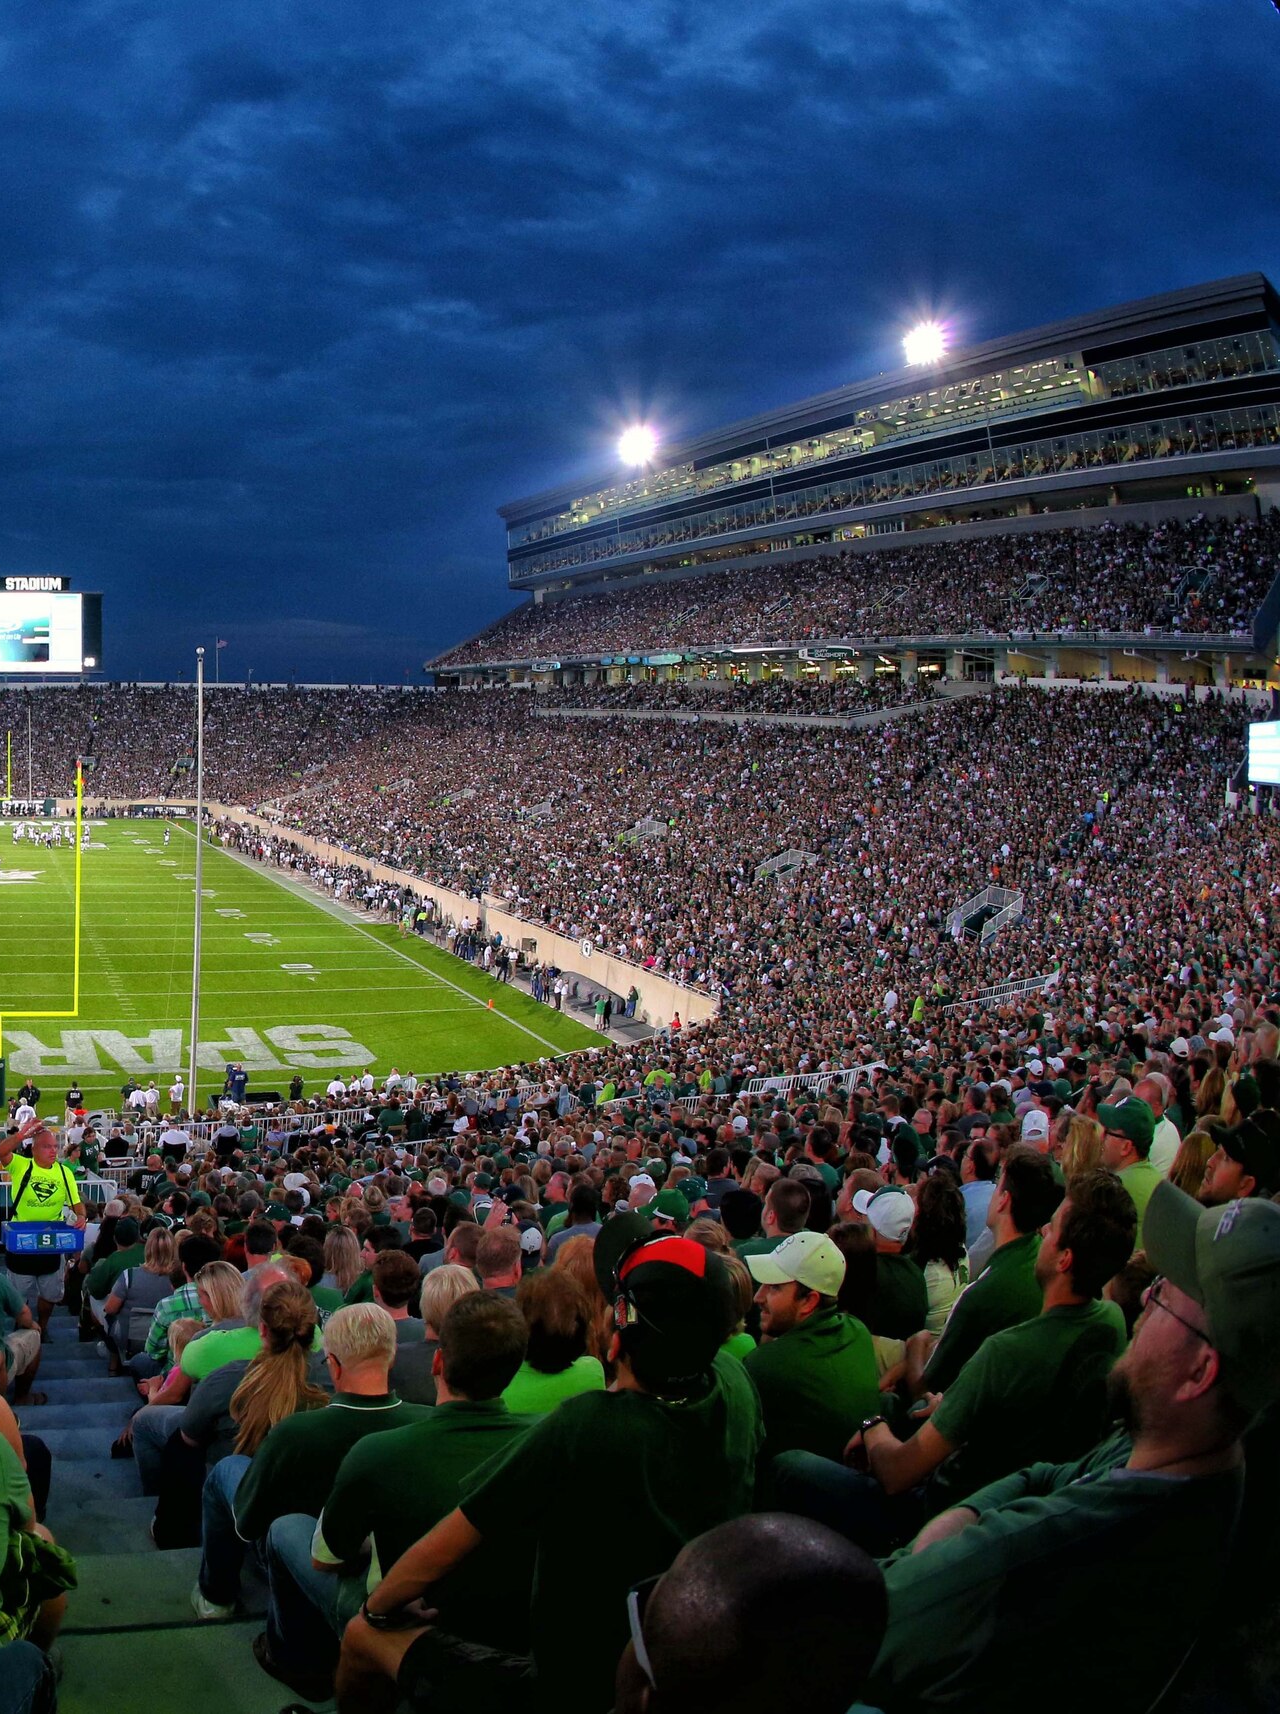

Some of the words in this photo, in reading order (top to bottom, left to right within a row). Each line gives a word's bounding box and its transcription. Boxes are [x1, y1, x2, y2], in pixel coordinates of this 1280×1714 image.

[5, 577, 62, 591] STADIUM
[280, 963, 321, 976] 10
[42, 1234, 51, 1245] S
